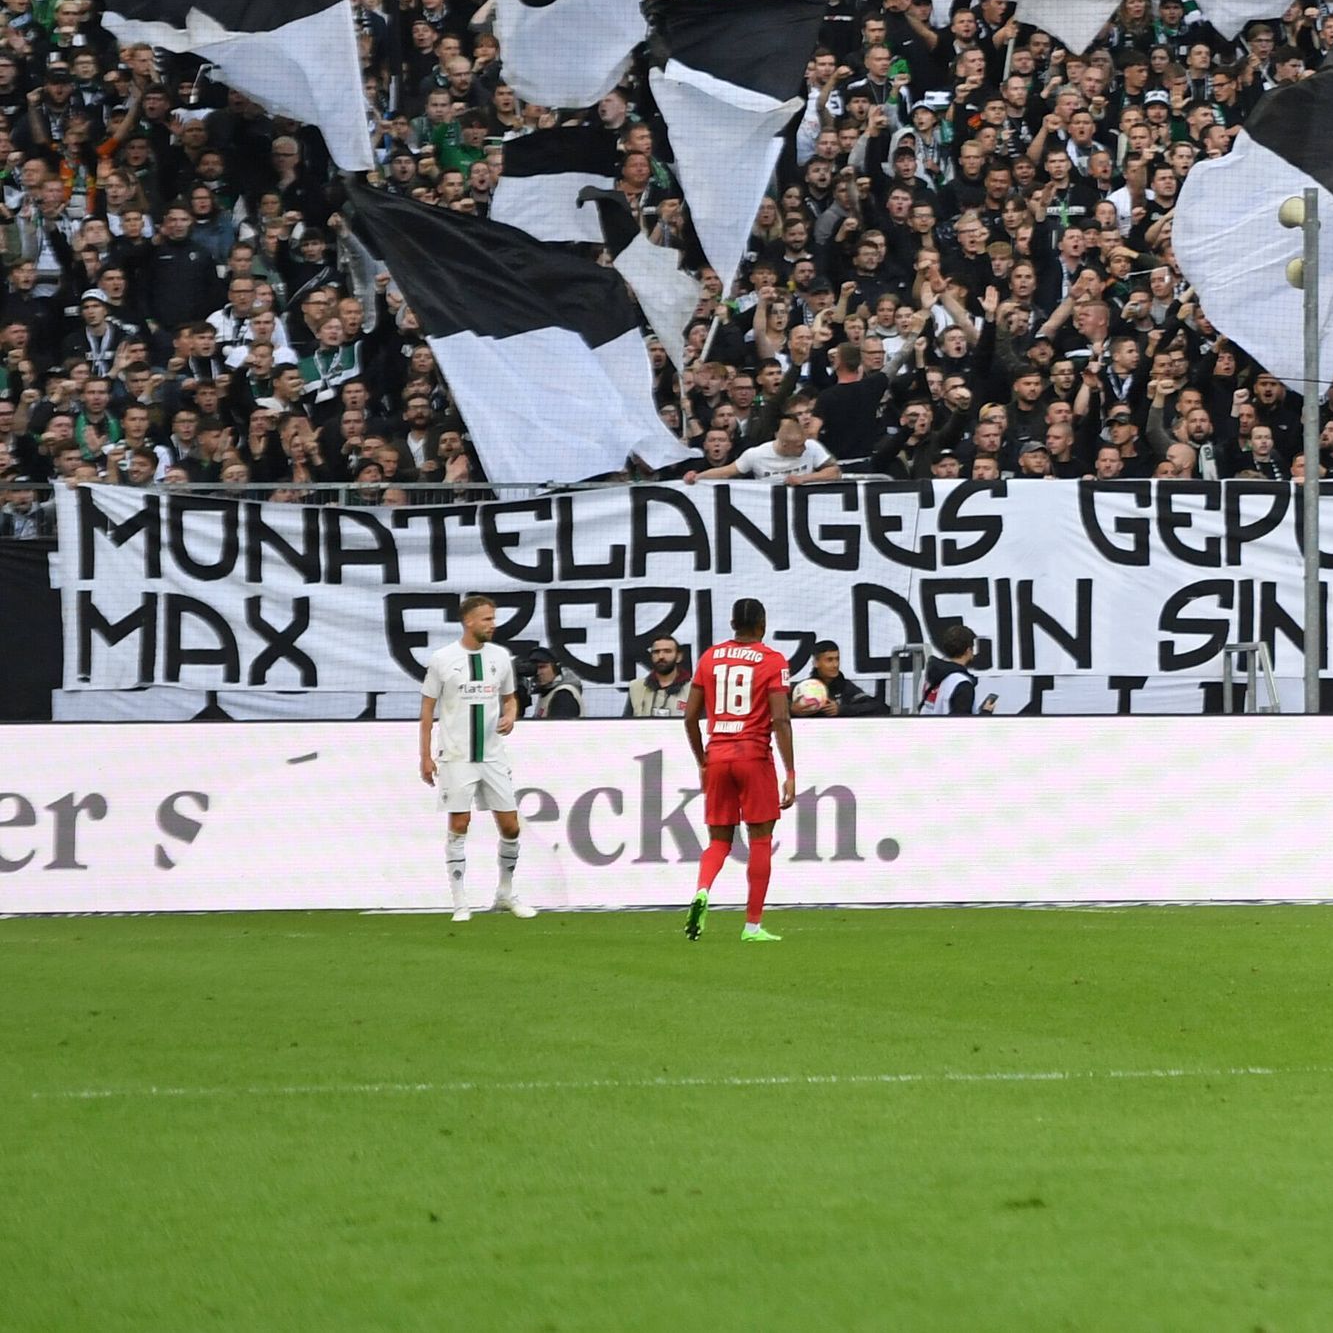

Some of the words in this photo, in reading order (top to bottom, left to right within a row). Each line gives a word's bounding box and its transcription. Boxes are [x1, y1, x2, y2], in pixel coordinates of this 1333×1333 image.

[78, 480, 1007, 583] MONATELANGES
[77, 590, 318, 687] MAX
[853, 577, 1092, 674] DEIN
[727, 647, 763, 663] LEIPZIG
[713, 664, 754, 716] 18
